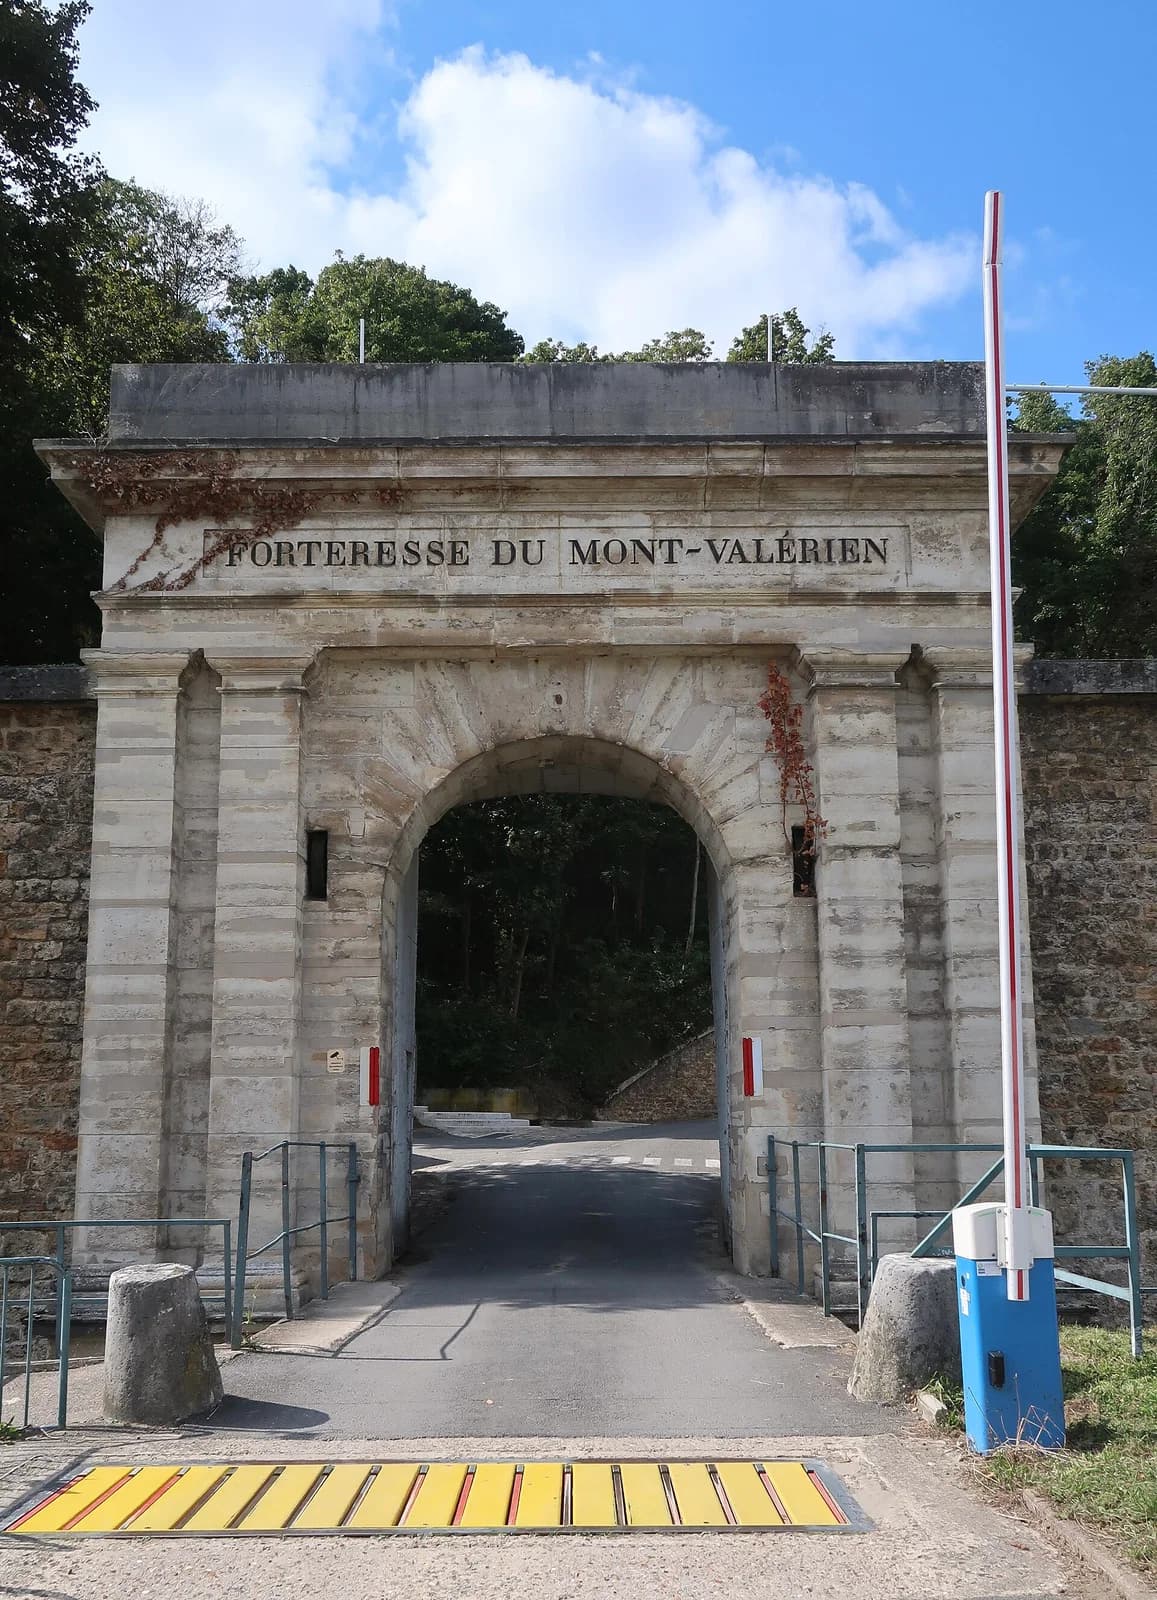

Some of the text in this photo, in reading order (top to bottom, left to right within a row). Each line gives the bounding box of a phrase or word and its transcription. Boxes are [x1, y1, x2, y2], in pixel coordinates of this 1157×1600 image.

[225, 530, 888, 568] FORTERESSE DU MONT-VALÉRIEN
